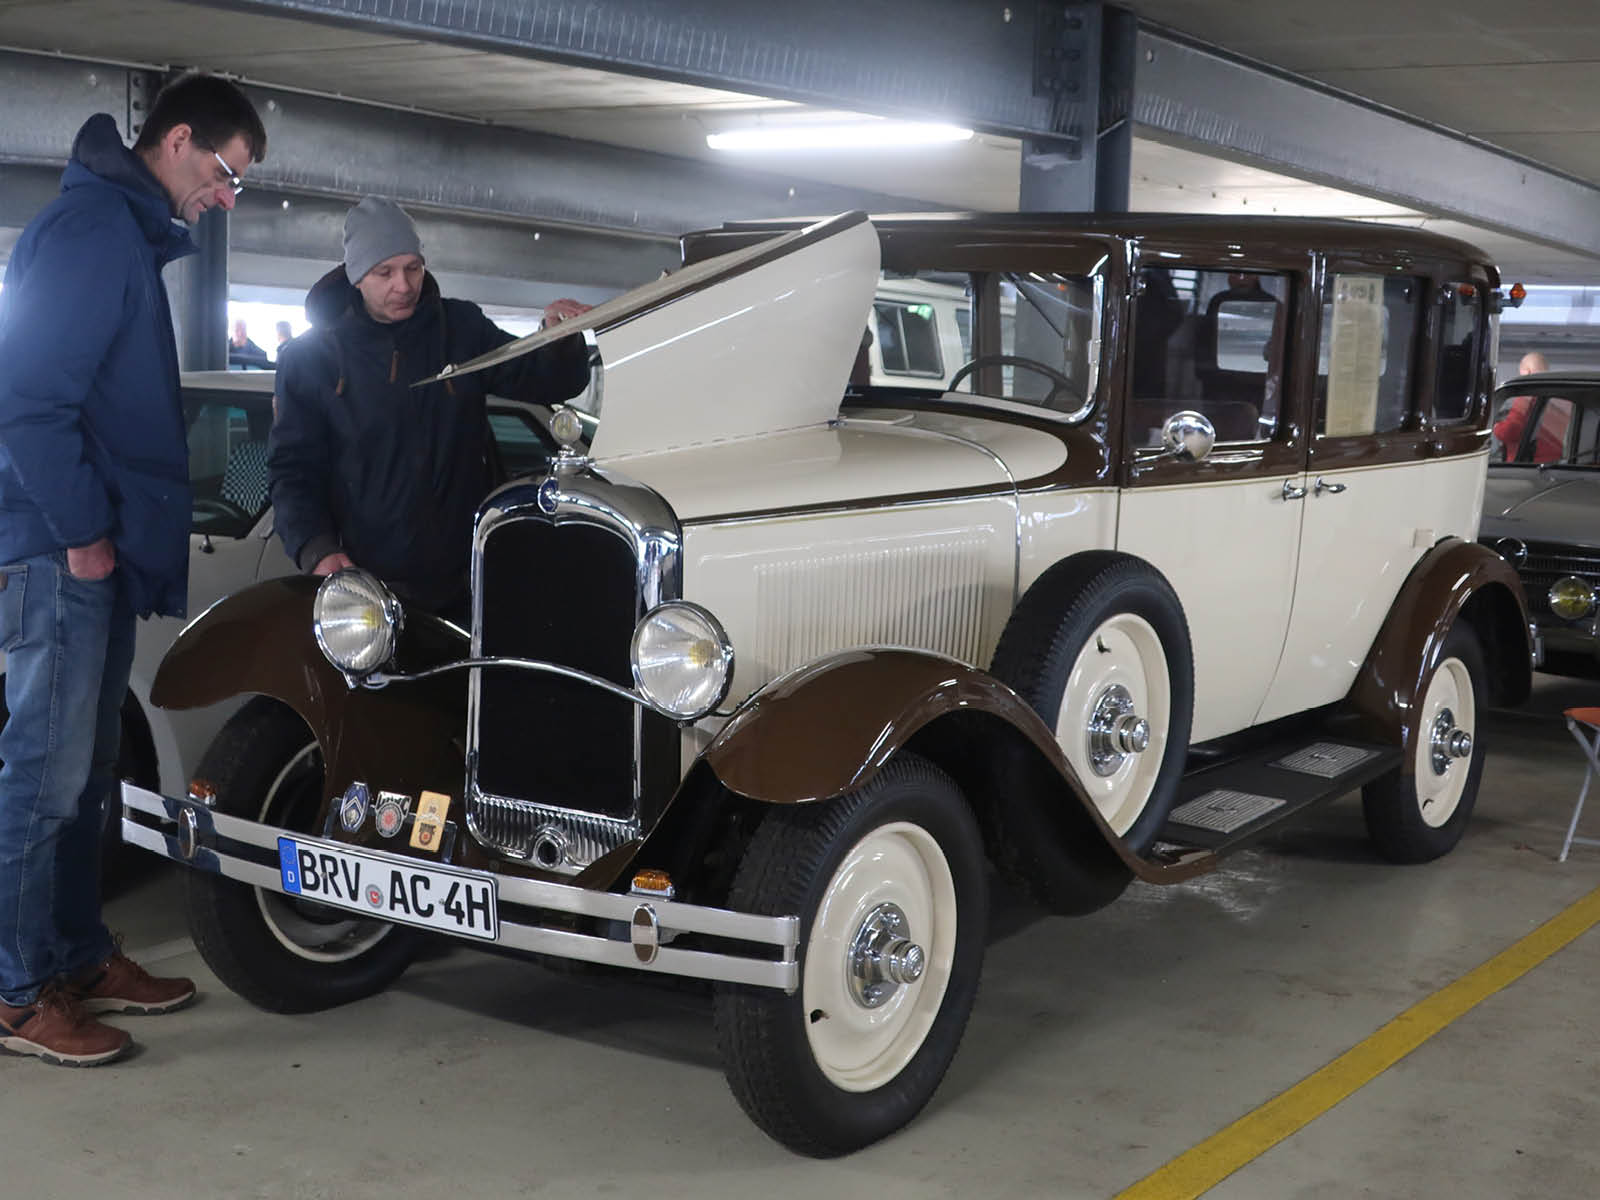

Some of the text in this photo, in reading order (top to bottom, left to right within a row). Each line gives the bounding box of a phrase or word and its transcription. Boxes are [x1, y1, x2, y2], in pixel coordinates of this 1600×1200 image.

[287, 870, 296, 884] D
[298, 848, 491, 931] BRV AC 4H
